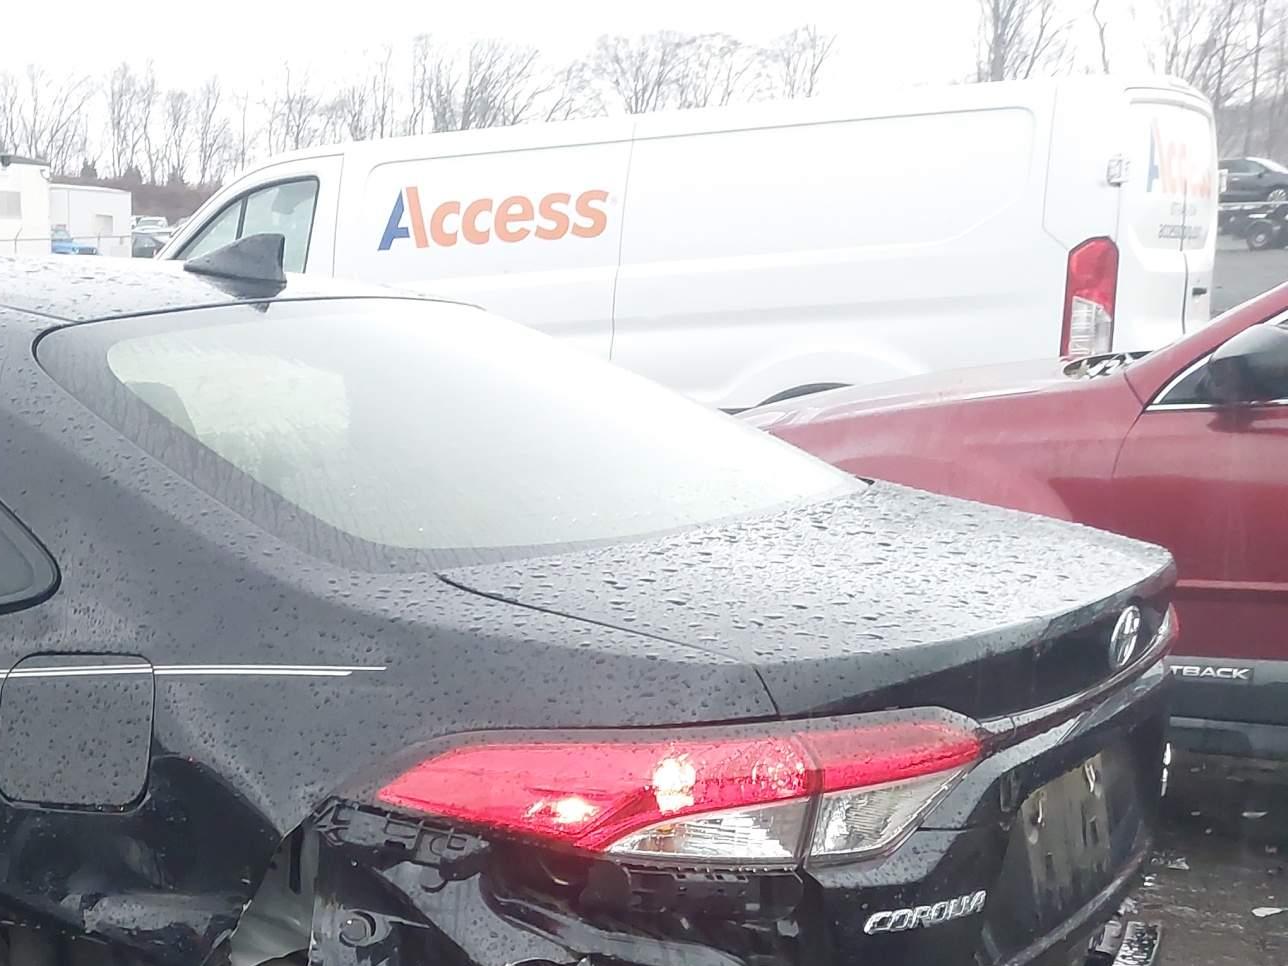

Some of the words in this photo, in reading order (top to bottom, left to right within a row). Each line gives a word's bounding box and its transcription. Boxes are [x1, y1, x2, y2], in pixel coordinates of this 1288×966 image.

[377, 186, 609, 251] Access
[1169, 664, 1250, 680] TBACK
[863, 890, 987, 935] COROLLA
